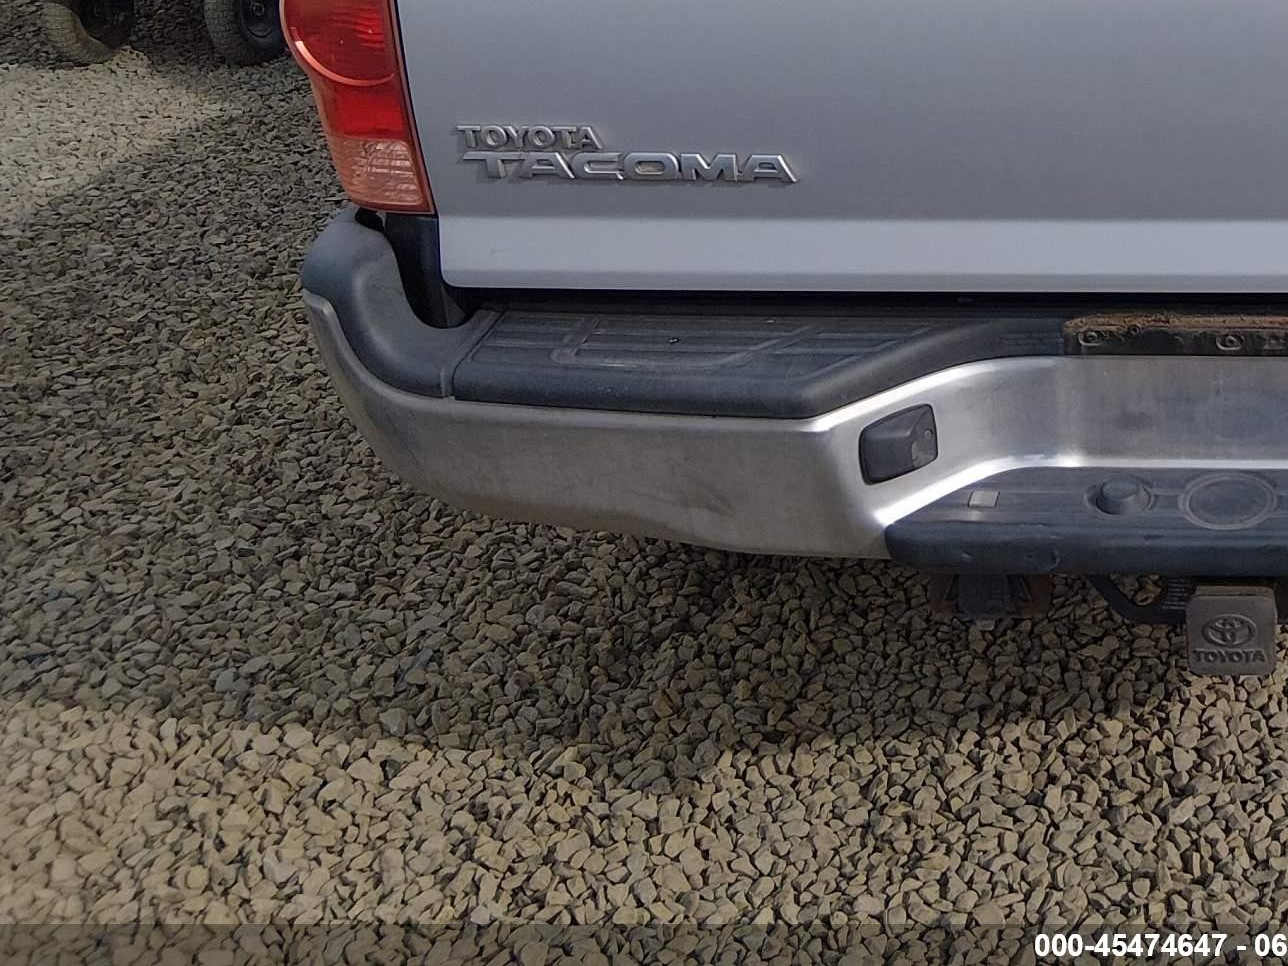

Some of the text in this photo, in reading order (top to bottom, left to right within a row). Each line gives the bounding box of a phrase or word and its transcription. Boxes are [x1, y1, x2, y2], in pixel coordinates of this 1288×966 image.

[455, 124, 603, 150] TOYOTA
[462, 151, 799, 184] TACOMA
[1192, 647, 1268, 663] TOYOTA
